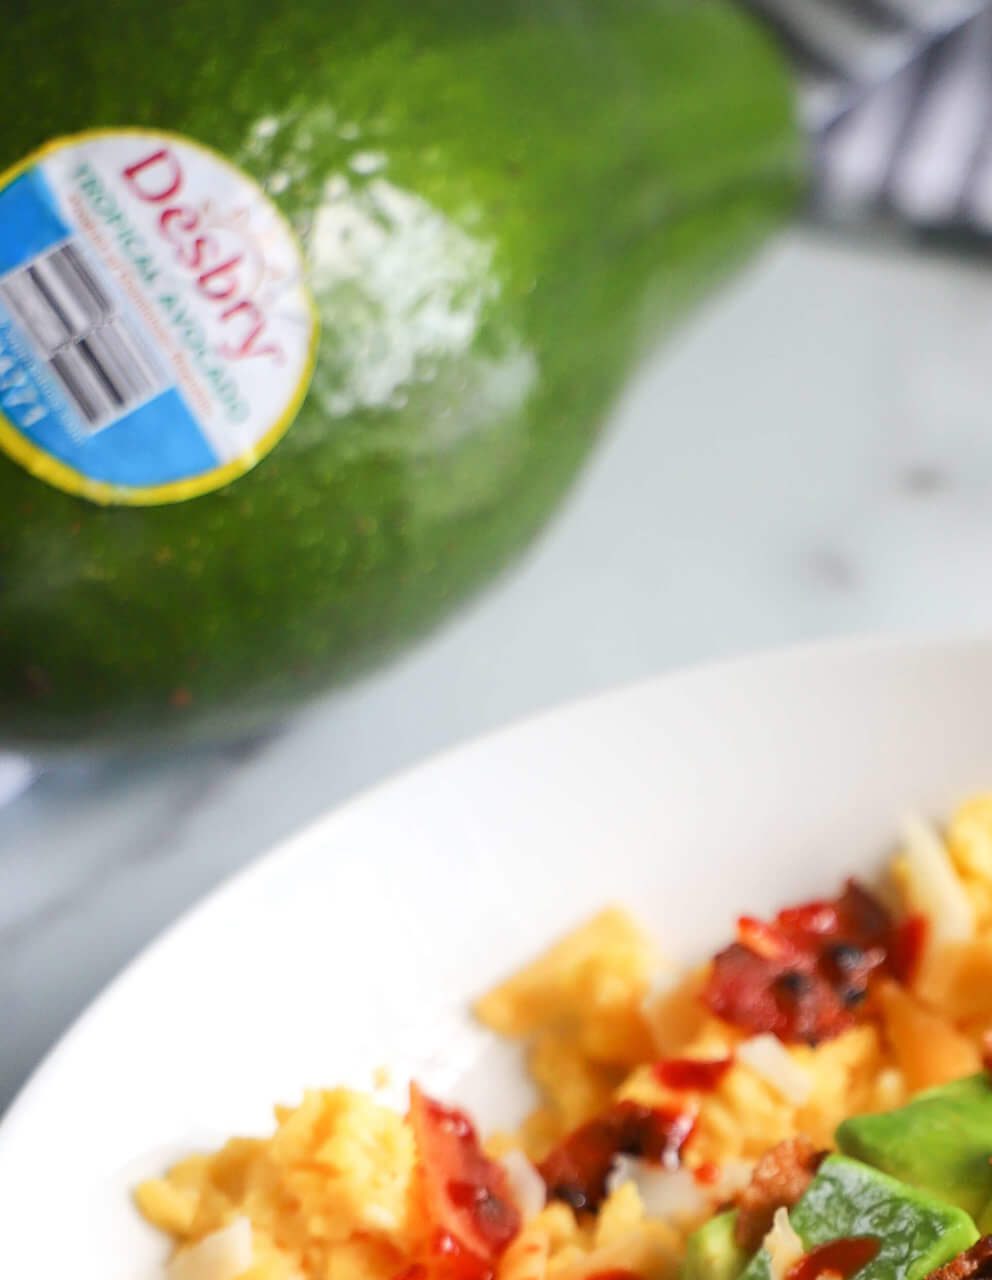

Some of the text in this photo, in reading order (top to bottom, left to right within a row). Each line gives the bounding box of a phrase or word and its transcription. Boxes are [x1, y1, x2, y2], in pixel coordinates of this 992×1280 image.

[75, 163, 161, 286] TROPICAL
[157, 293, 250, 424] AVOCADO
[122, 149, 284, 364] Desbry
